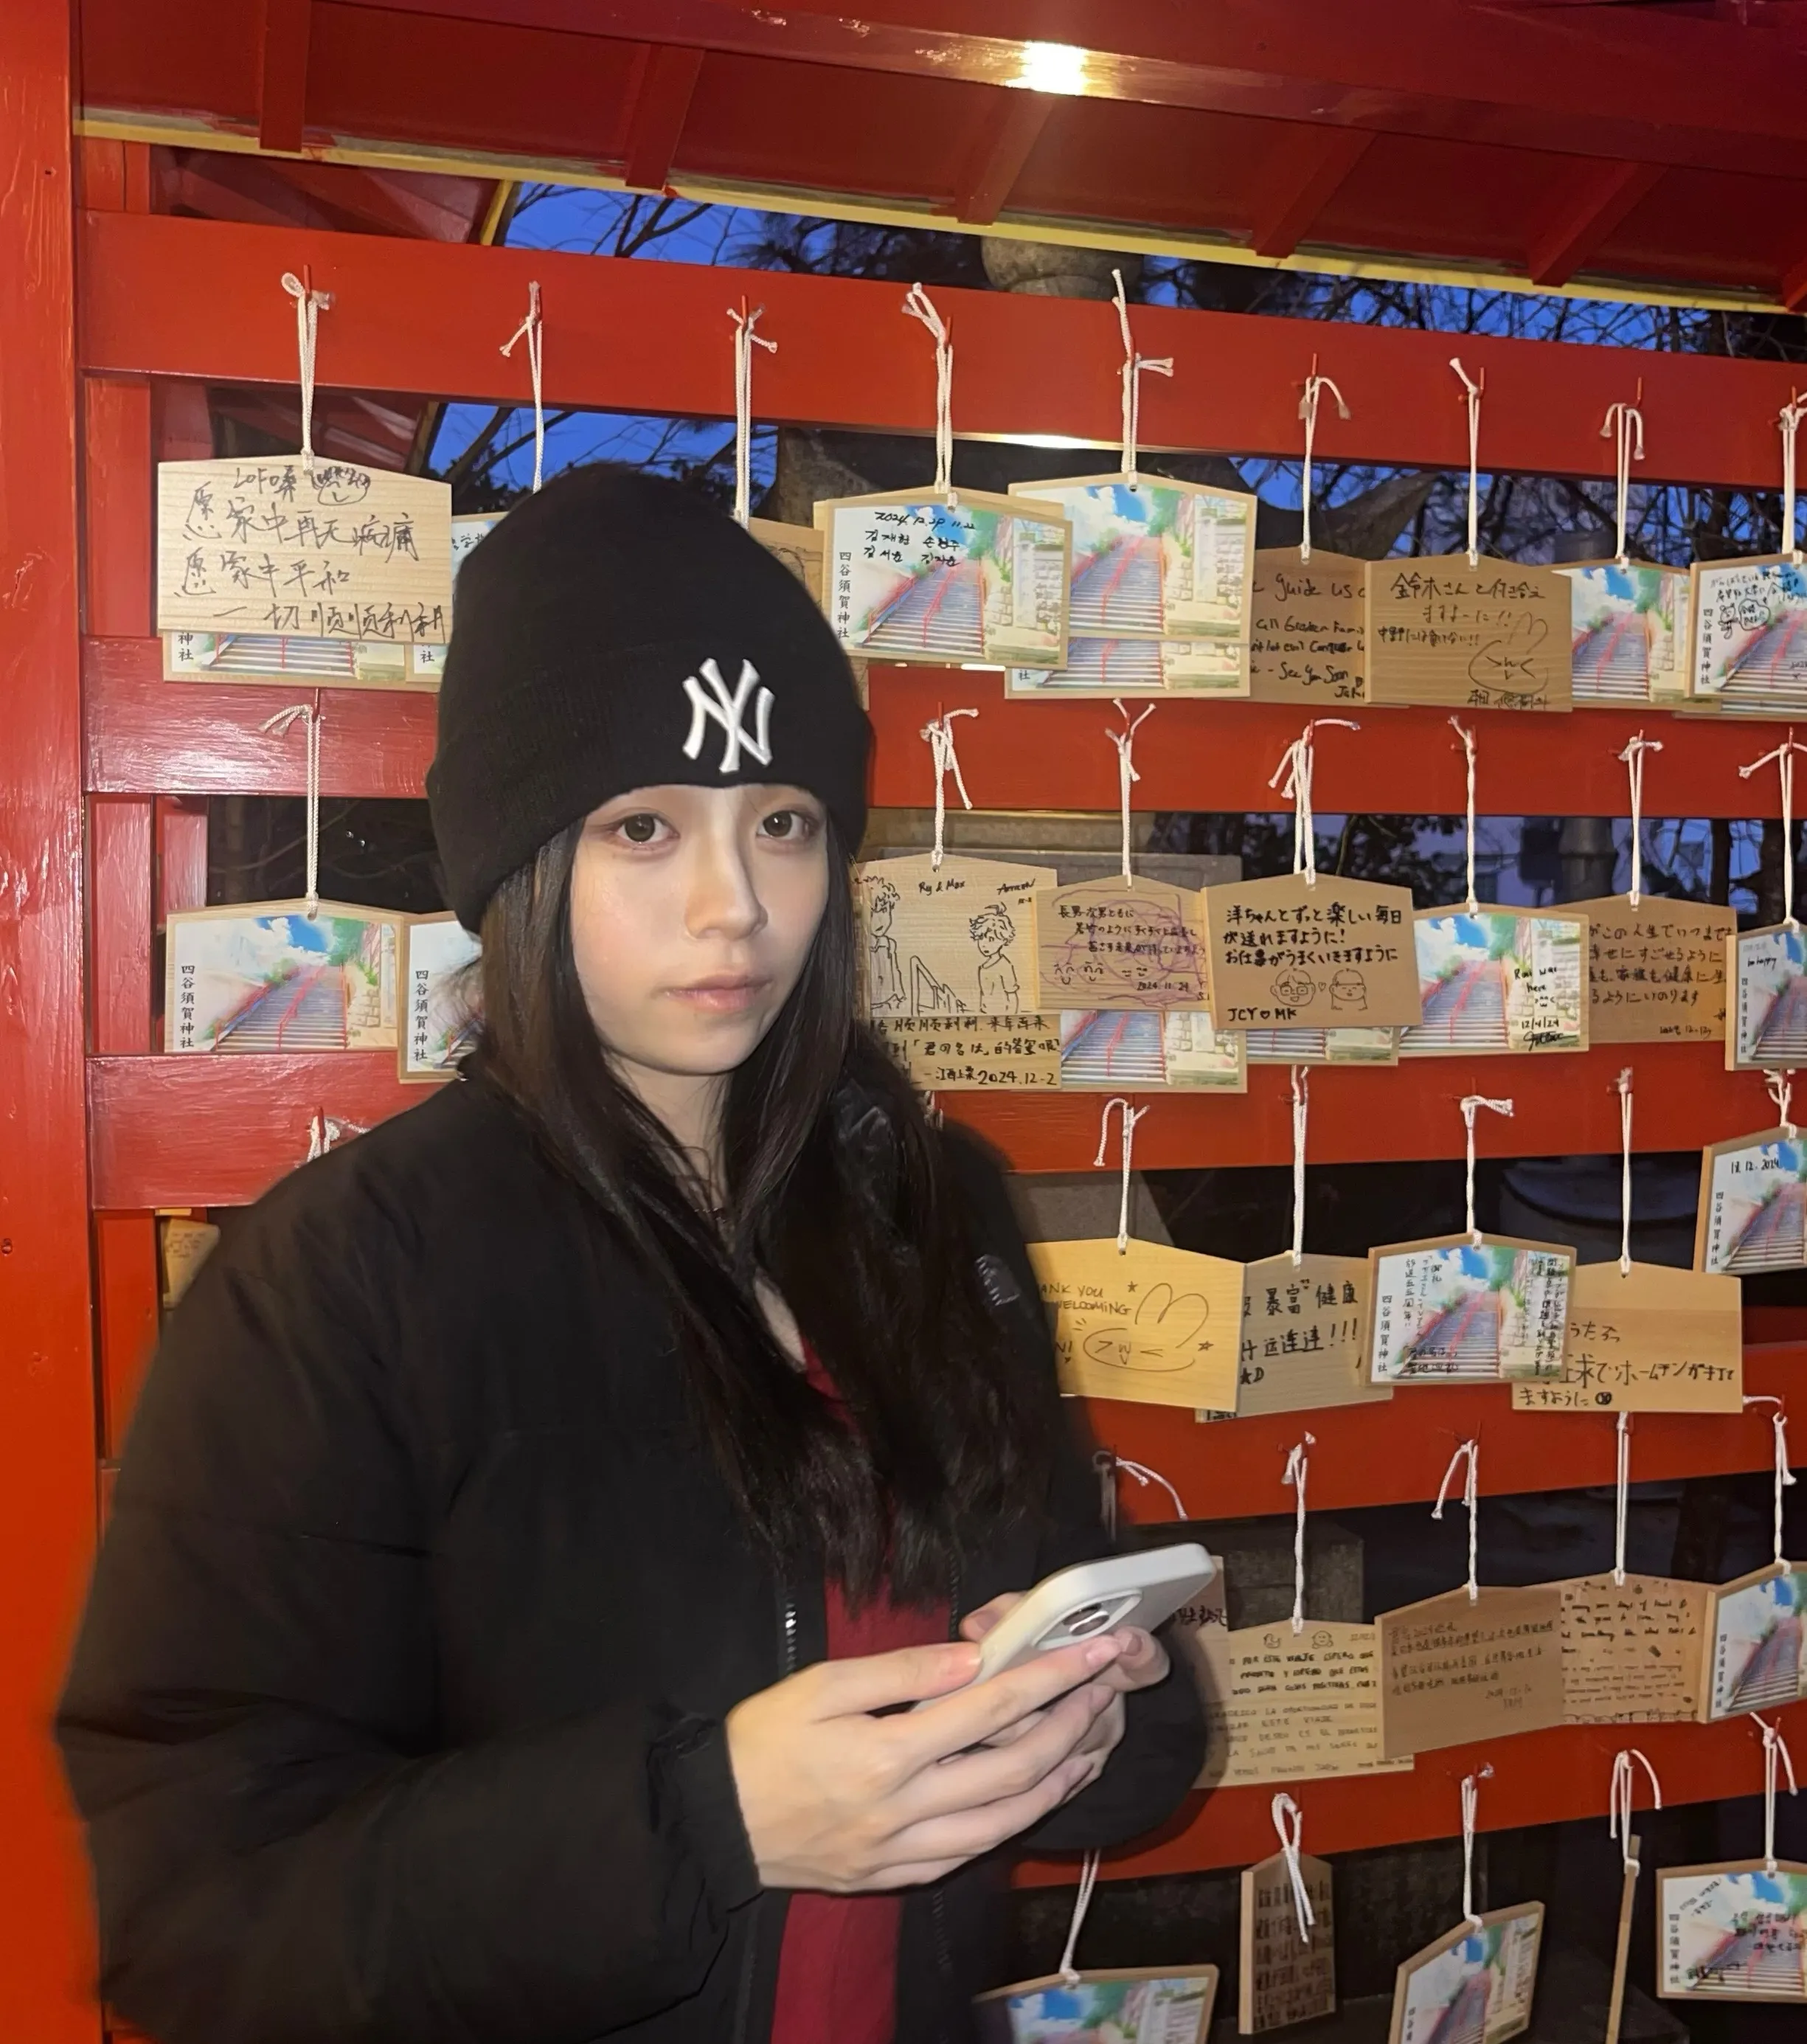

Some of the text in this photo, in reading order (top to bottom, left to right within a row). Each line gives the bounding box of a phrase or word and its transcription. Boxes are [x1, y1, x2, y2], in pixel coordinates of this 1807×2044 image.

[837, 552, 852, 639] 四谷須賀神社
[682, 657, 775, 773] NY
[181, 965, 195, 1048] 四谷須賀神社
[414, 970, 429, 1061] 四谷須賀神社
[1377, 1295, 1392, 1372] 四谷須賀神社
